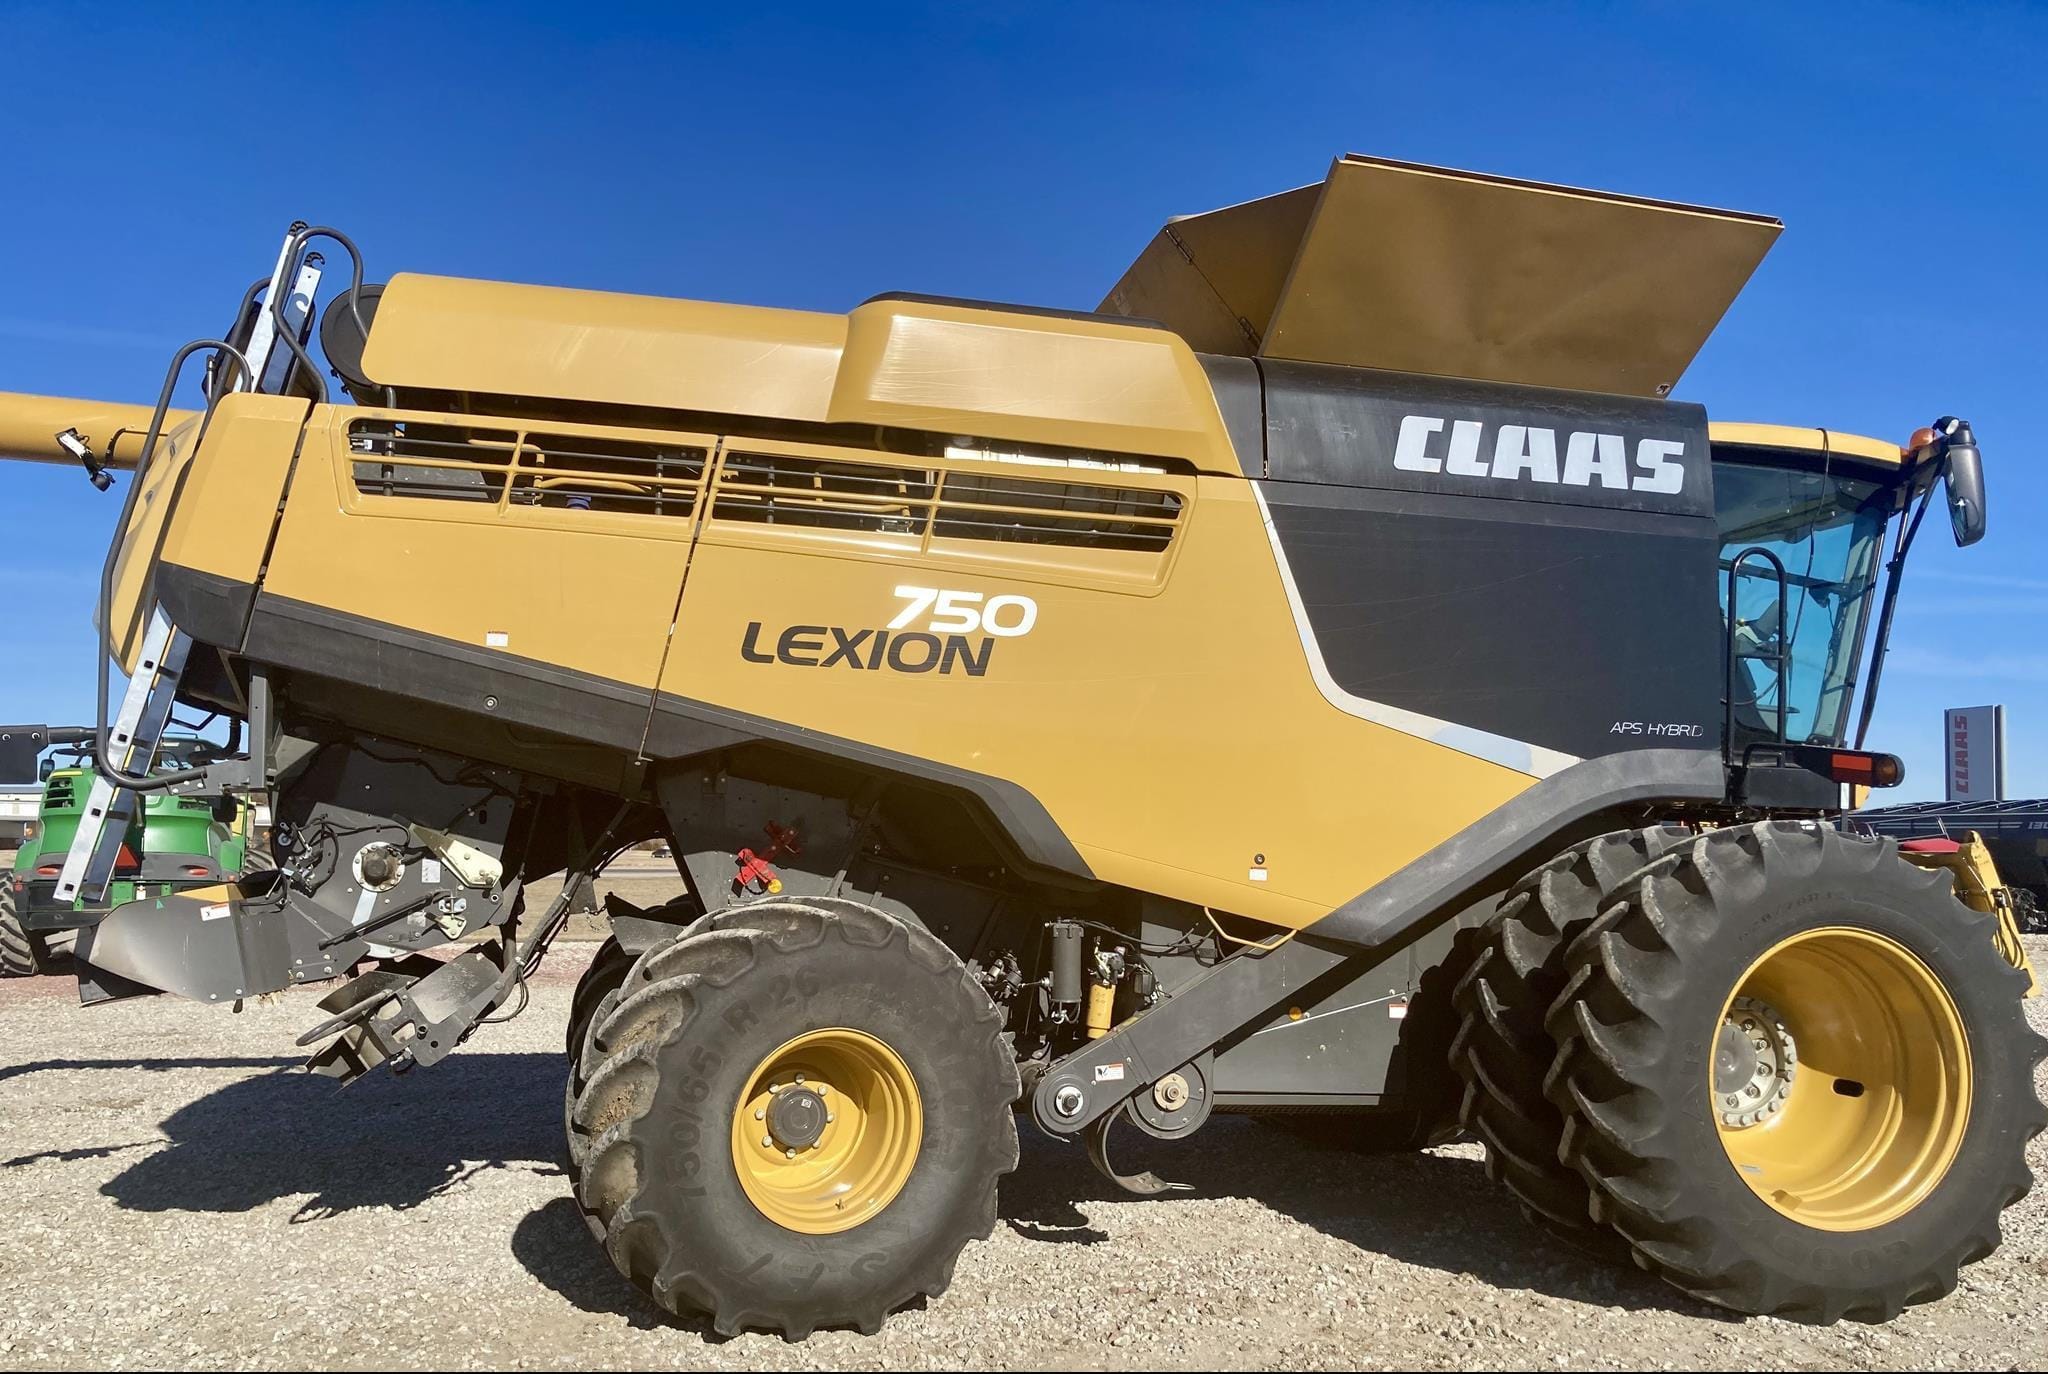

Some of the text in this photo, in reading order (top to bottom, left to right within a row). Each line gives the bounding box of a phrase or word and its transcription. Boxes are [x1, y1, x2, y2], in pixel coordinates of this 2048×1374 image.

[1393, 414, 1685, 495] CLAAS
[886, 585, 1038, 638] 750
[740, 621, 995, 677] LEXION
[1609, 721, 1644, 736] APS
[1953, 715, 1969, 794] CLAAS
[721, 998, 761, 1038] R
[767, 964, 822, 1009] 26
